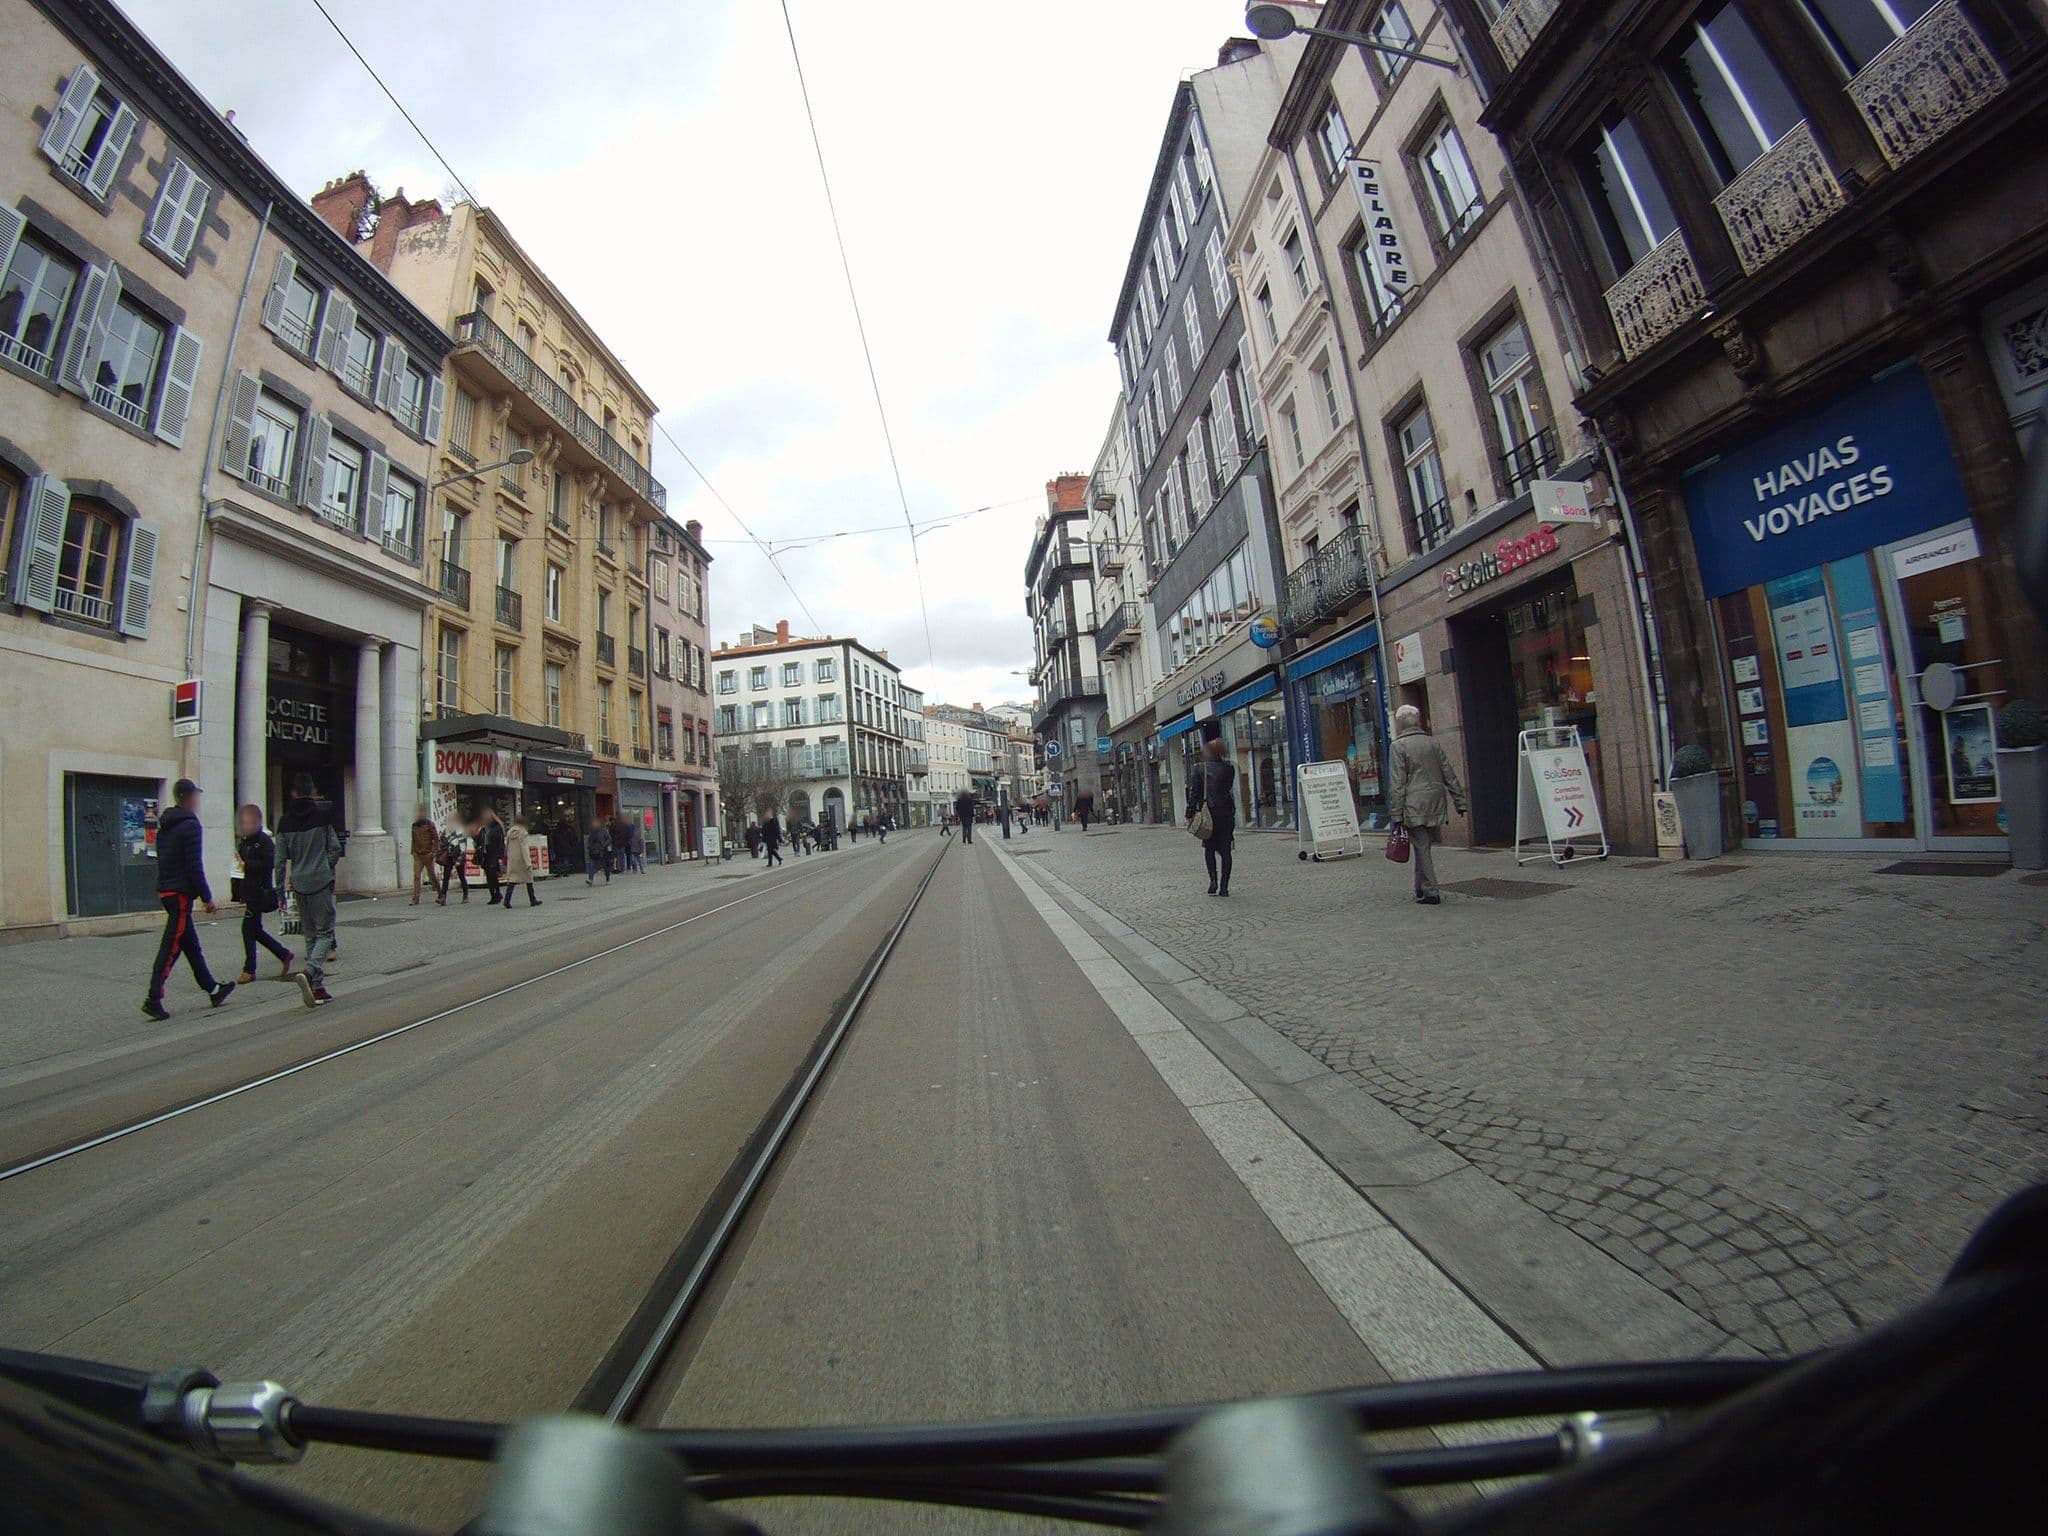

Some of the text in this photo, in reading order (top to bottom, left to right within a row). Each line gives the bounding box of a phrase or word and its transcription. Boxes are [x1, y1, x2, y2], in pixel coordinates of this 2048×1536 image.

[1358, 166, 1407, 284] DELABRE
[1752, 435, 1860, 502] HAVAS
[1743, 465, 1893, 542] VOYAGES
[1458, 524, 1558, 592] SoluSons
[1262, 632, 1279, 640] Cook
[267, 695, 328, 723] OCIETE
[266, 719, 331, 745] NERAL
[435, 750, 492, 776] BOOK'IN
[1543, 768, 1583, 780] SoluSons
